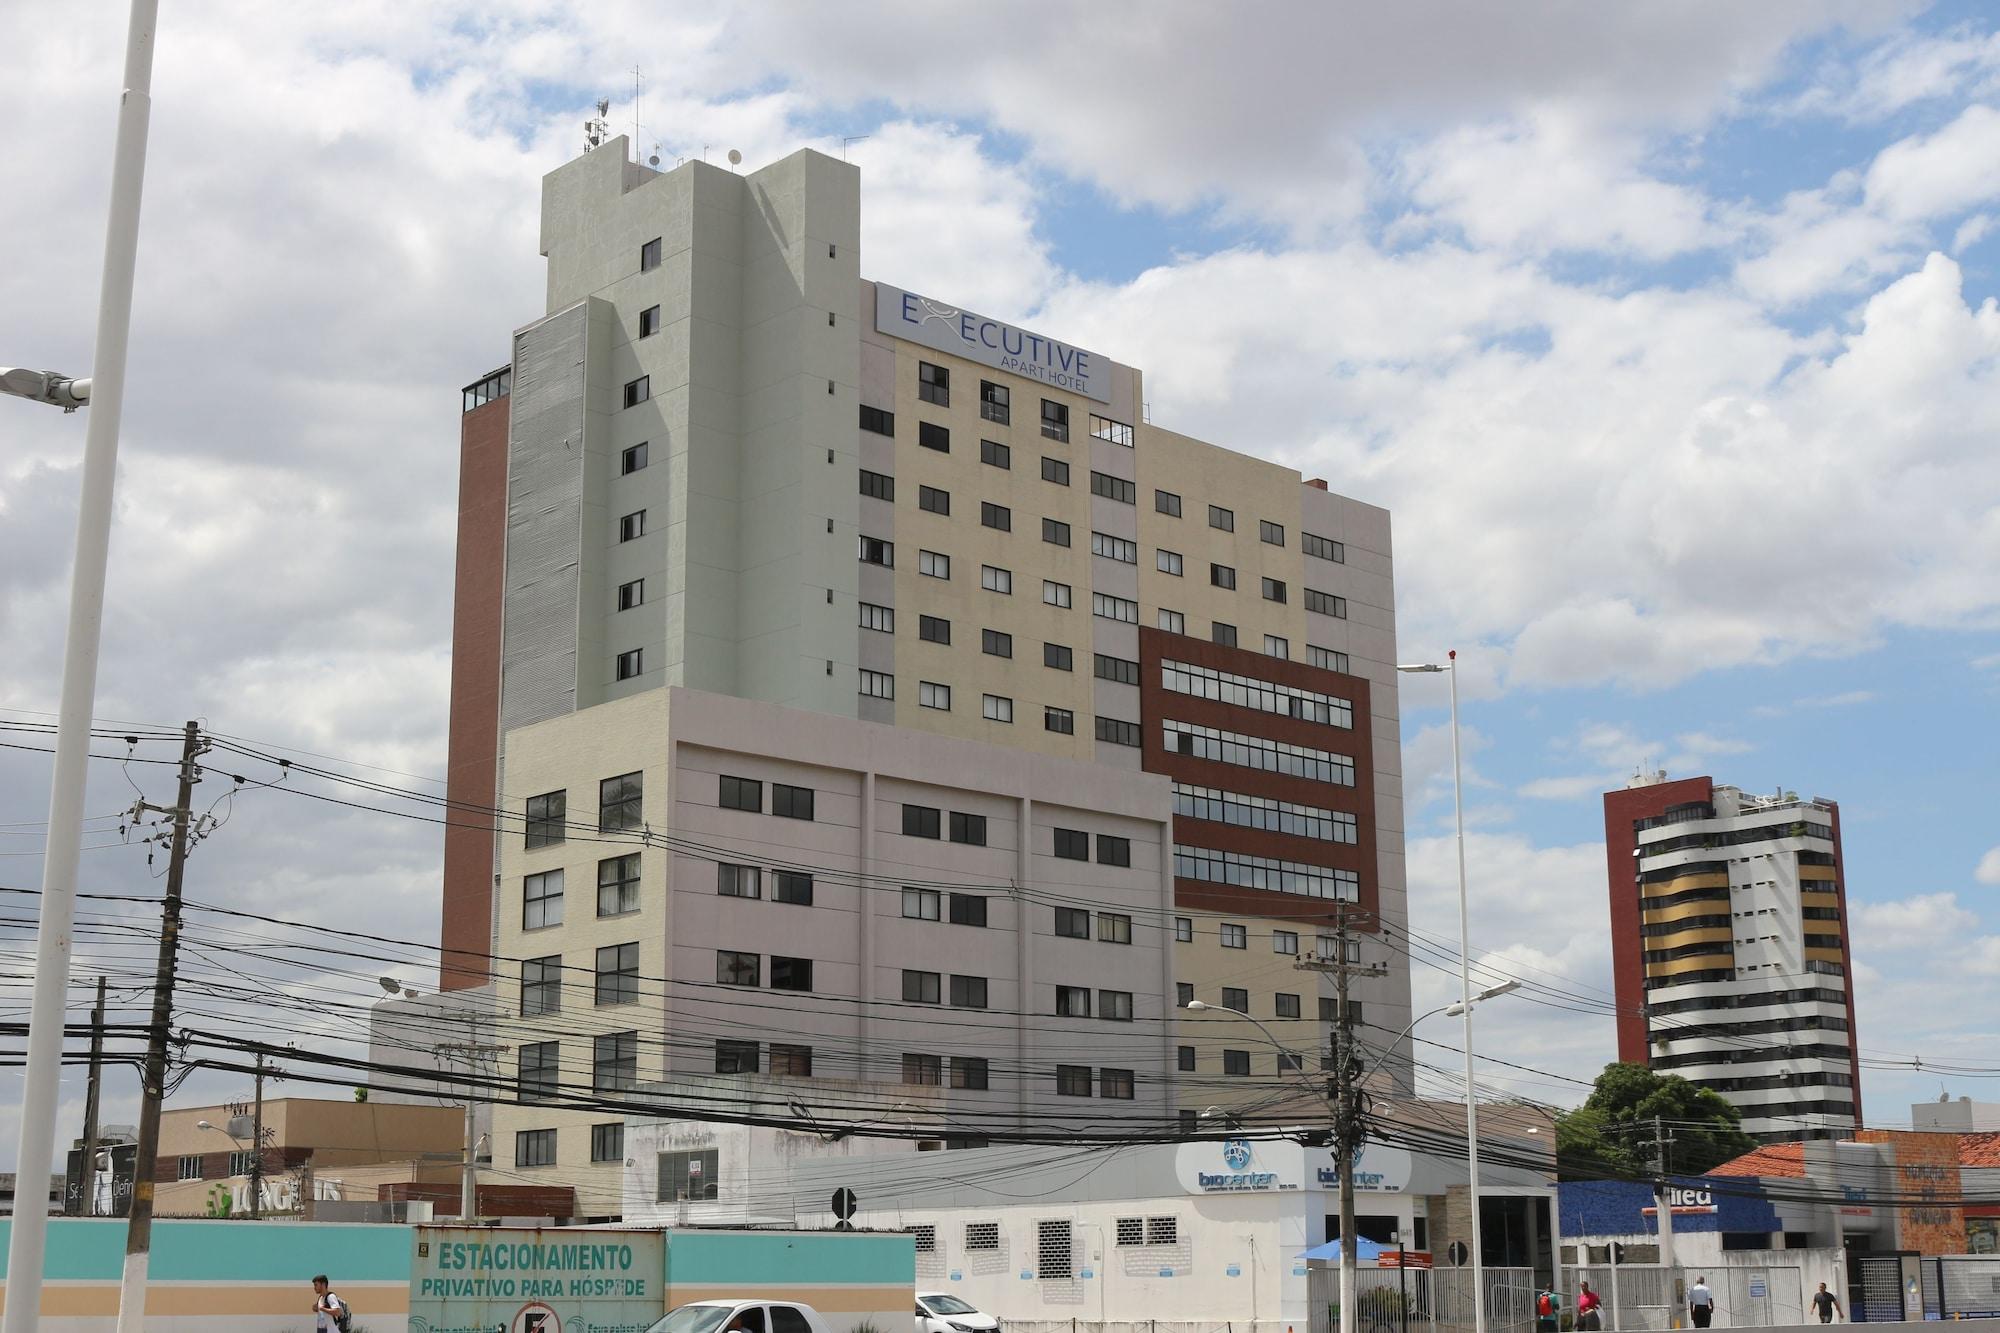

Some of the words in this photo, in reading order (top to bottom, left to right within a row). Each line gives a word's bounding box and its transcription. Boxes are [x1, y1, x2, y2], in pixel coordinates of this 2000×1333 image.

[902, 293, 1090, 379] EXECUTIVE
[1000, 355, 1045, 379] APART
[1048, 371, 1089, 394] HOTEL
[1198, 1171, 1278, 1187] biocenter
[1317, 1167, 1385, 1185] bionter
[438, 1242, 633, 1271] ESTACIONAMENTO
[421, 1278, 516, 1297] PRIVATIVO
[520, 1279, 565, 1297] PARA
